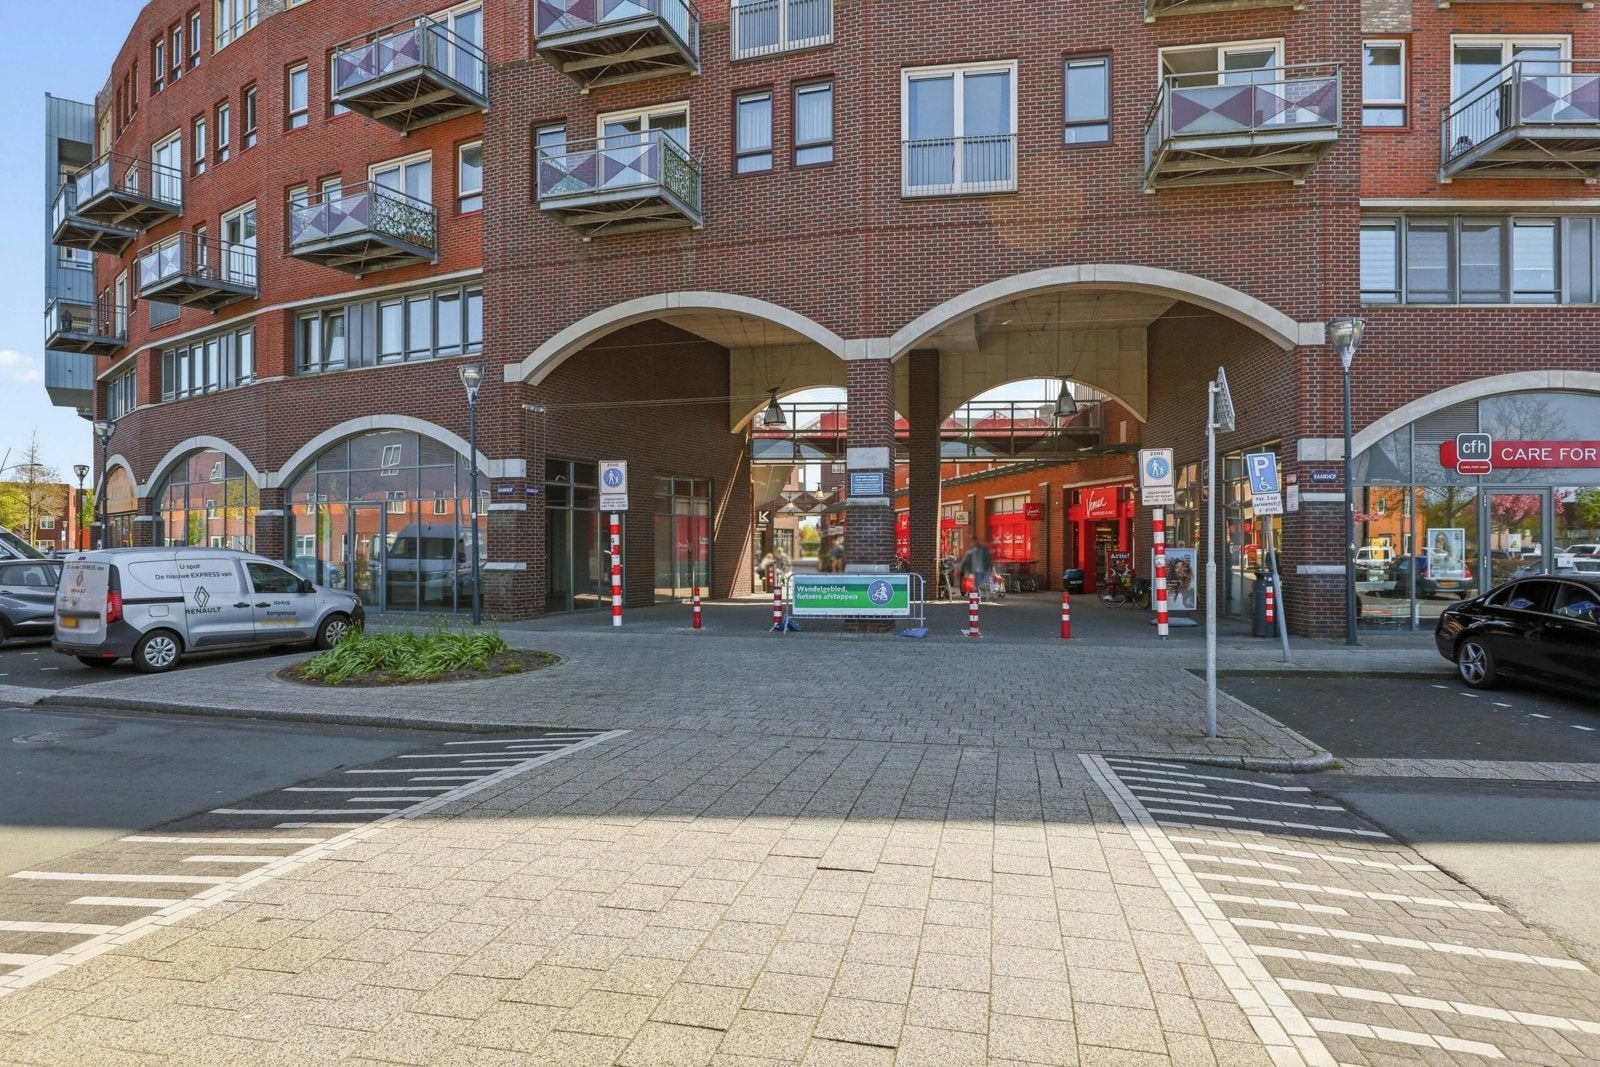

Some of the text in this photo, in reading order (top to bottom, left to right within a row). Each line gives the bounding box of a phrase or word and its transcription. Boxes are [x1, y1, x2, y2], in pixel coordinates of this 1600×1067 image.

[1462, 440, 1487, 454] cfh
[1501, 448, 1597, 461] CARE FOR
[1253, 456, 1269, 477] P
[185, 606, 221, 615] RENAULT
